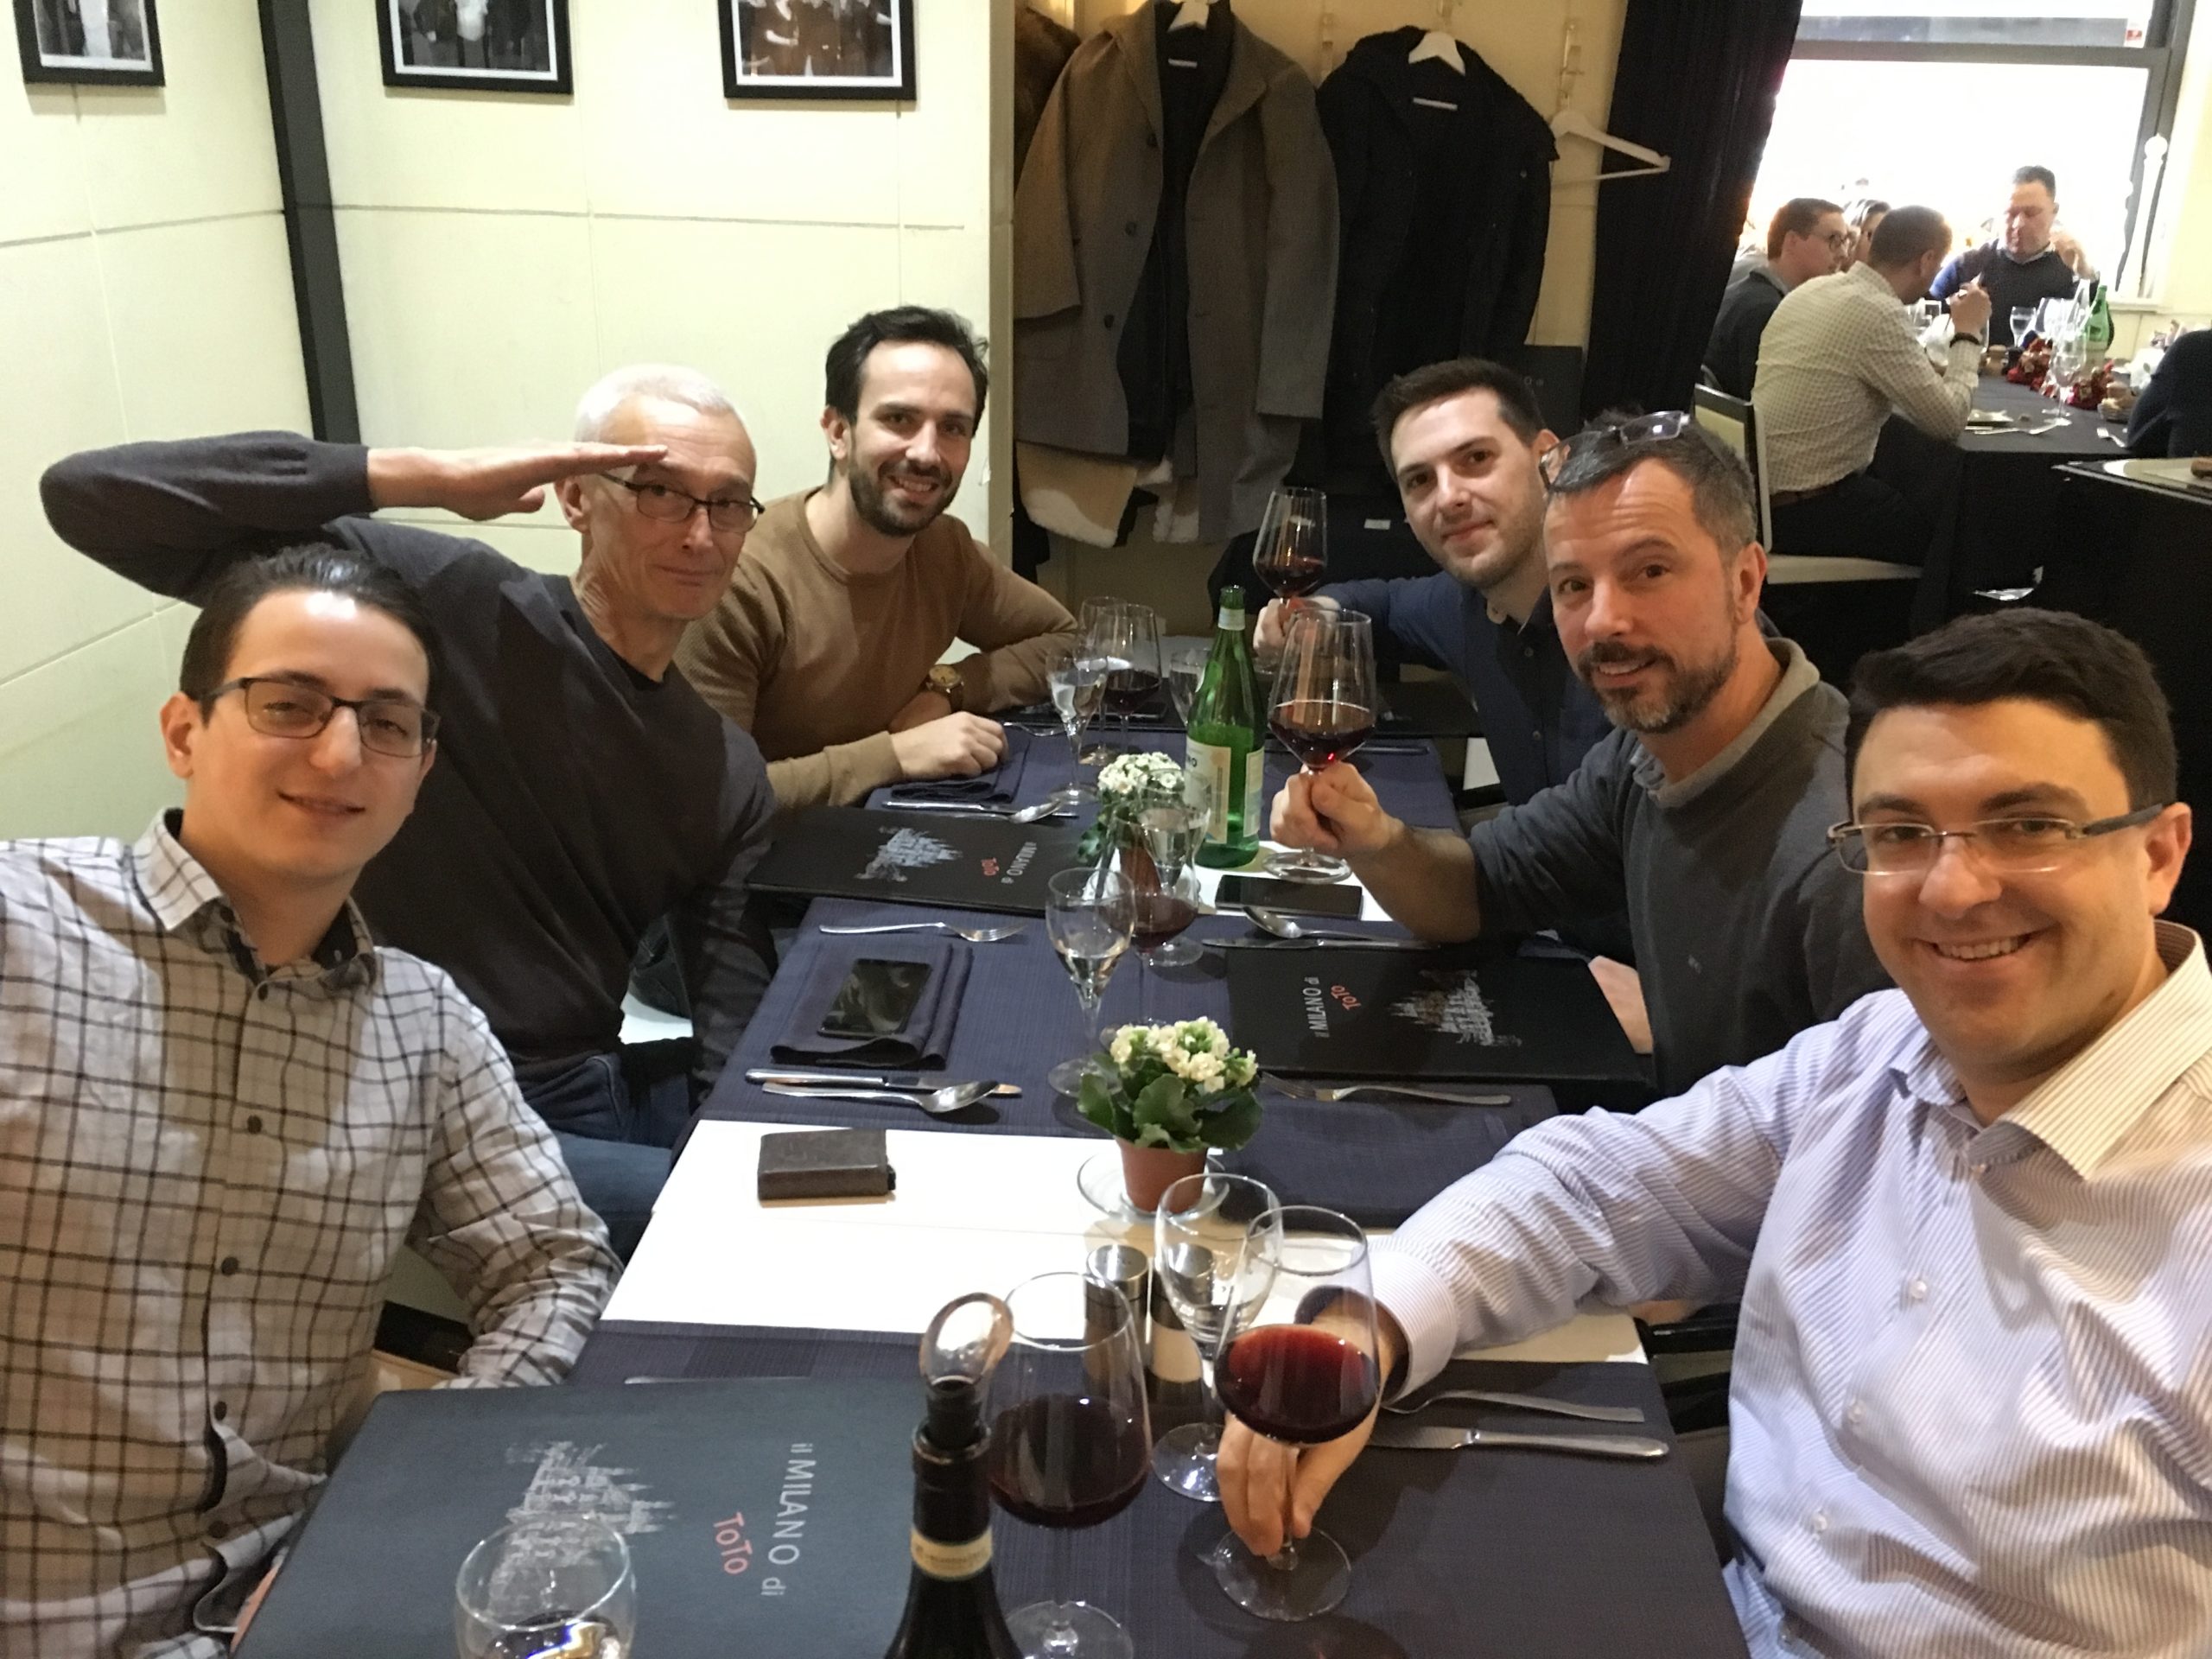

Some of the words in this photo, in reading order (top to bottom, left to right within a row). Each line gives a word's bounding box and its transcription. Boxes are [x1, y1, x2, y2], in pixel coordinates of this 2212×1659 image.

[1006, 847, 1038, 876] MILANO
[1302, 987, 1328, 1030] MILANO
[790, 1442, 814, 1453] il
[768, 1459, 817, 1566] MILANO
[760, 1576, 787, 1596] di
